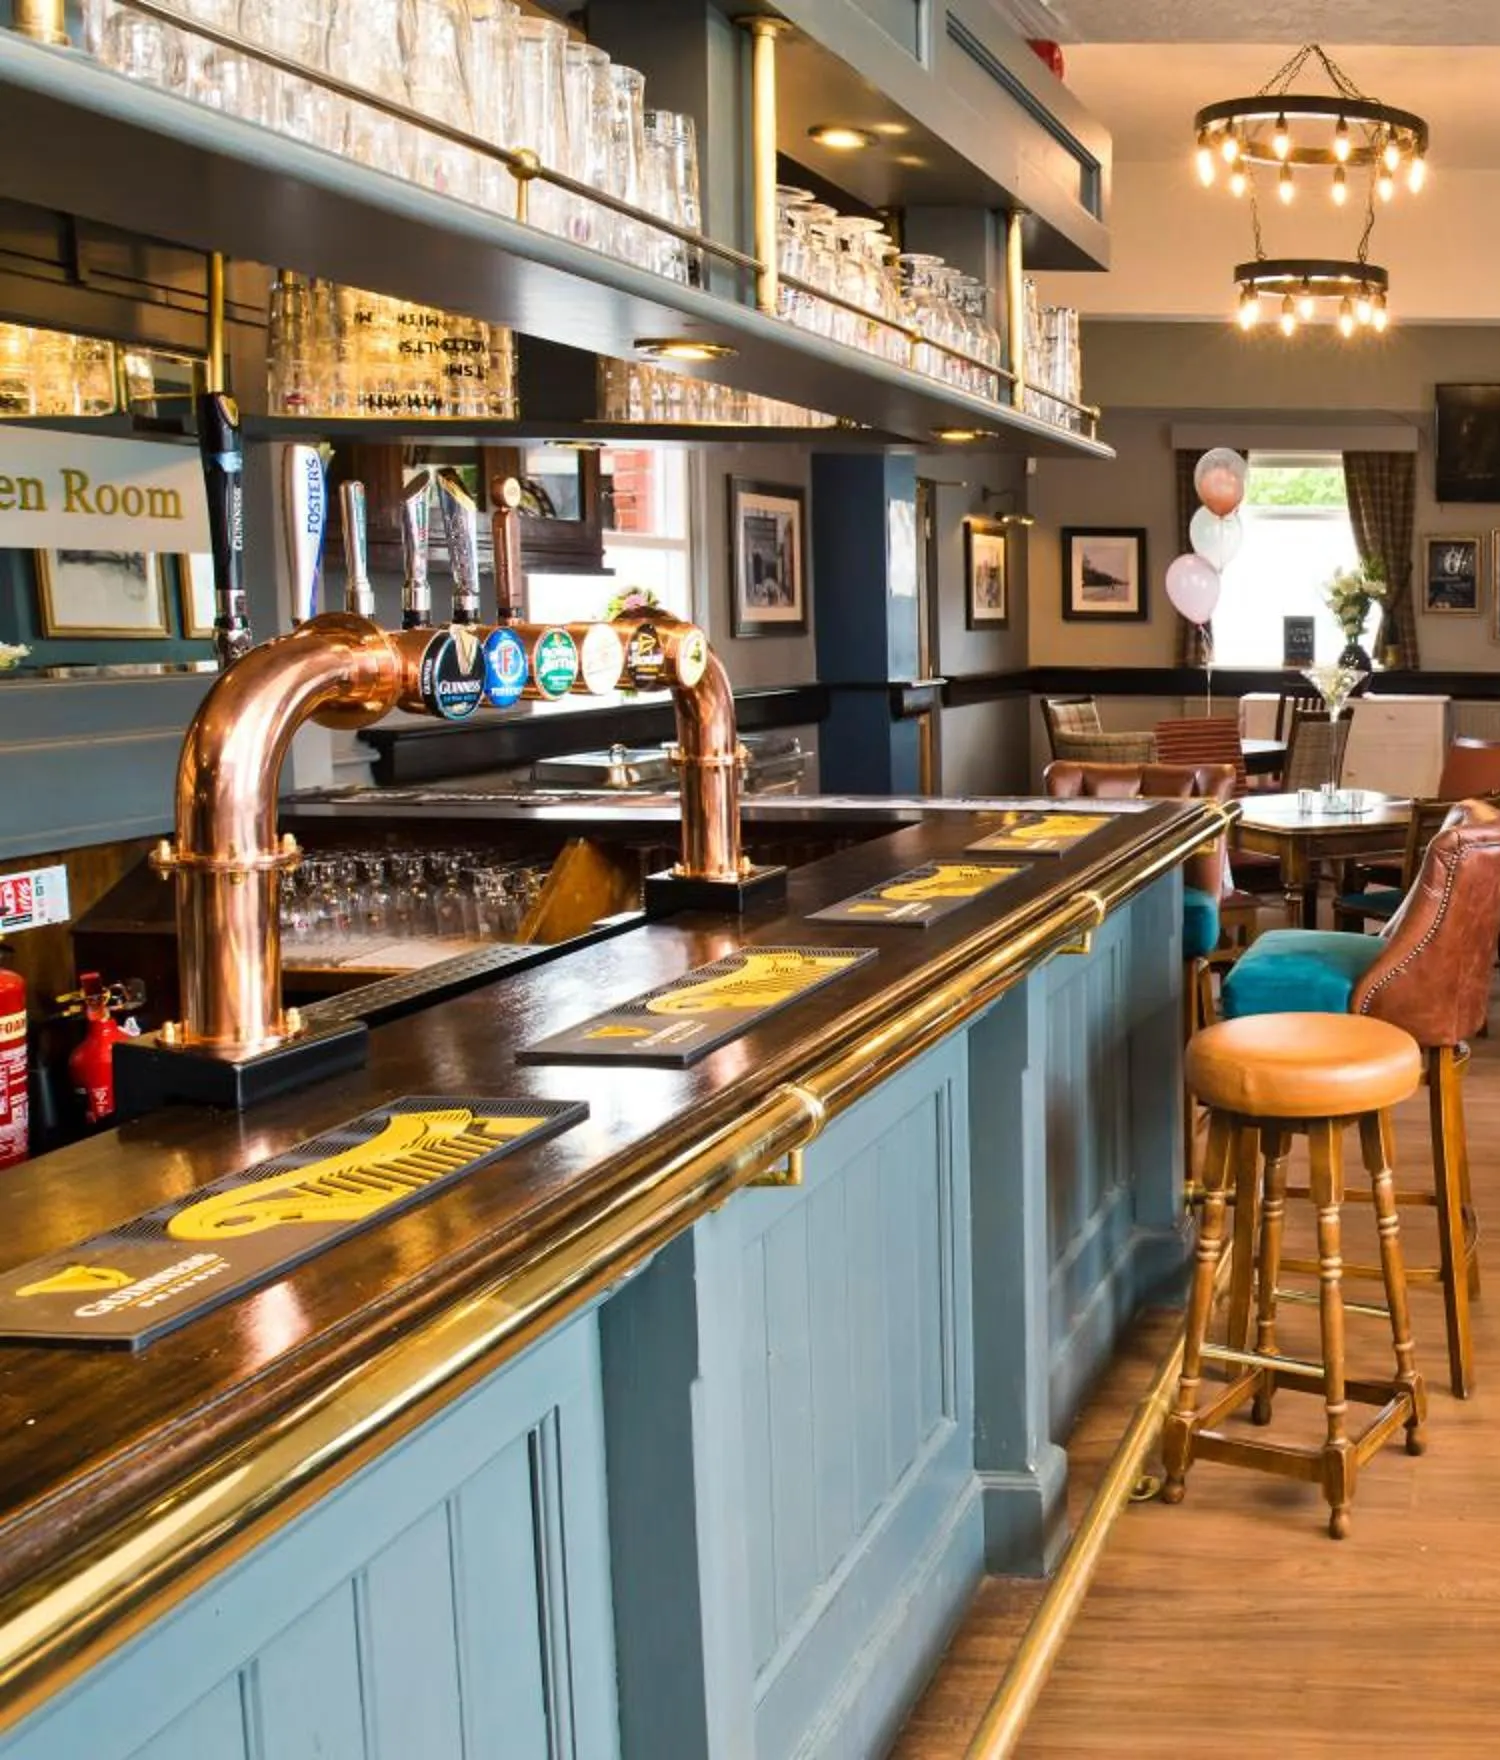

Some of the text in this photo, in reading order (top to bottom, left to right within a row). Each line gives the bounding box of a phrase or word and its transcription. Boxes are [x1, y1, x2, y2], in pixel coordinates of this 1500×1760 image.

[59, 467, 183, 519] Room
[308, 457, 320, 534] FOSTER'S
[440, 679, 481, 695] GUINNESS
